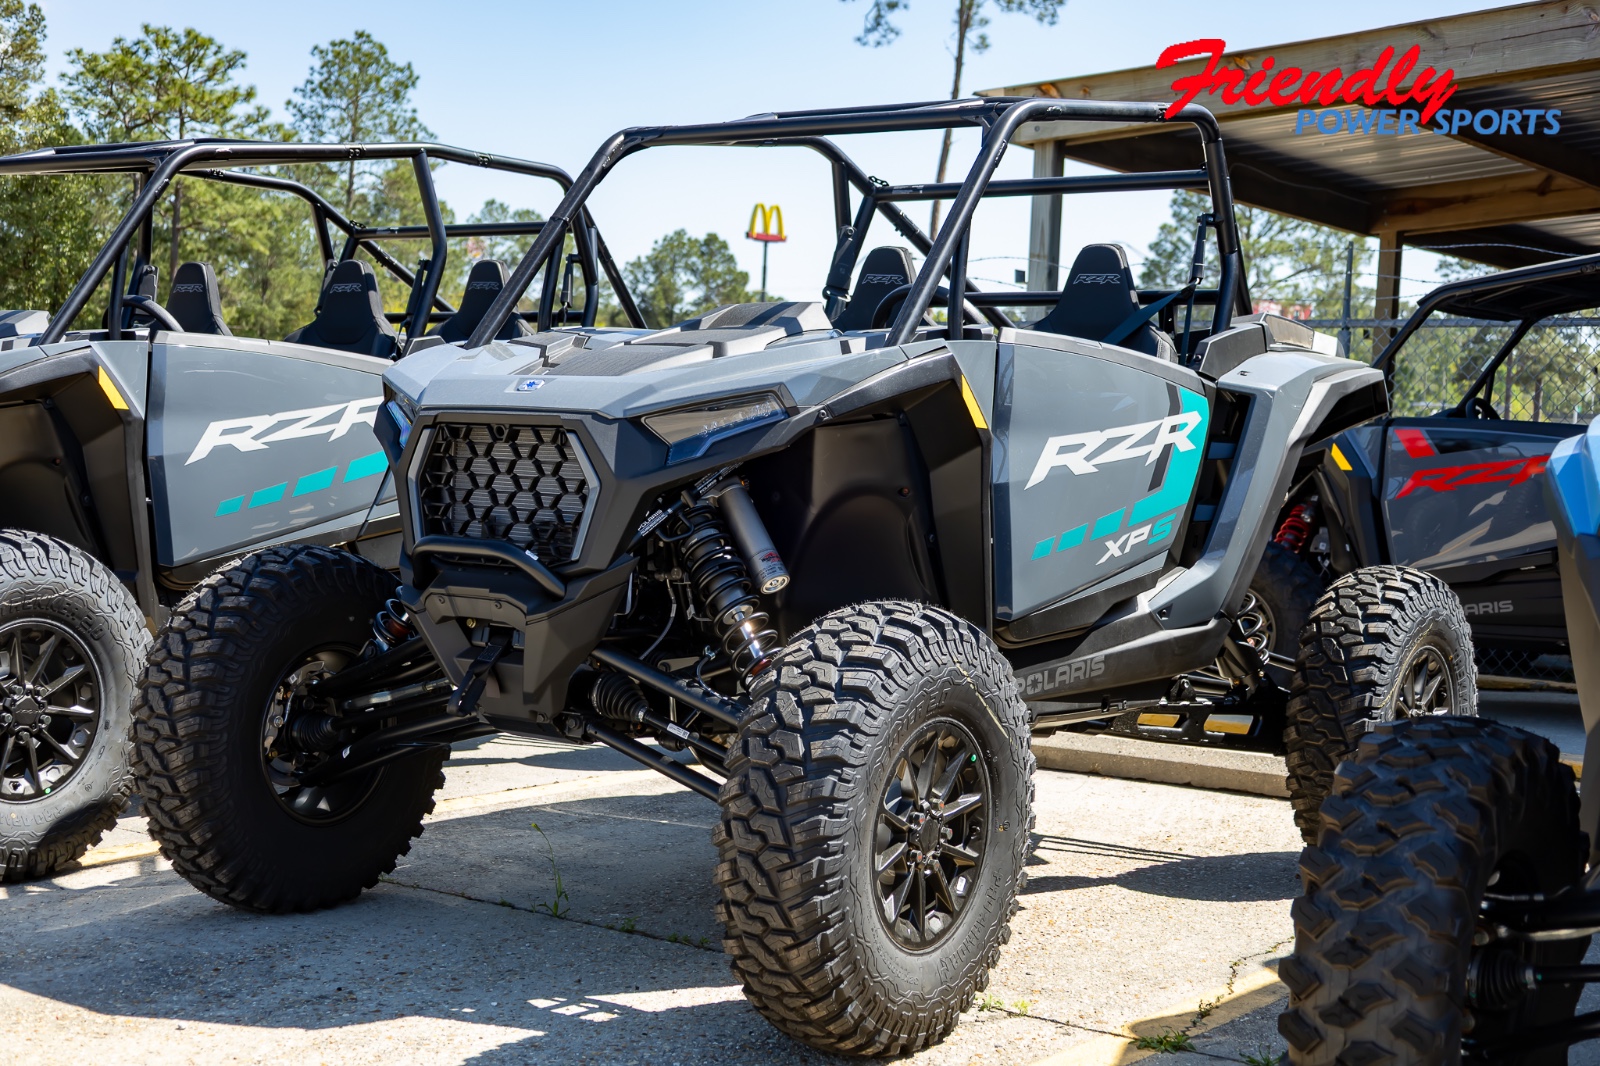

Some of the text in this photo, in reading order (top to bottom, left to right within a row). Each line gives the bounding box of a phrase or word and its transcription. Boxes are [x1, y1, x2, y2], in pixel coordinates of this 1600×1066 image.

[862, 274, 904, 284] RZR
[1073, 274, 1120, 284] RZR
[1024, 411, 1202, 490] RZR
[1464, 600, 1514, 616] ARIS
